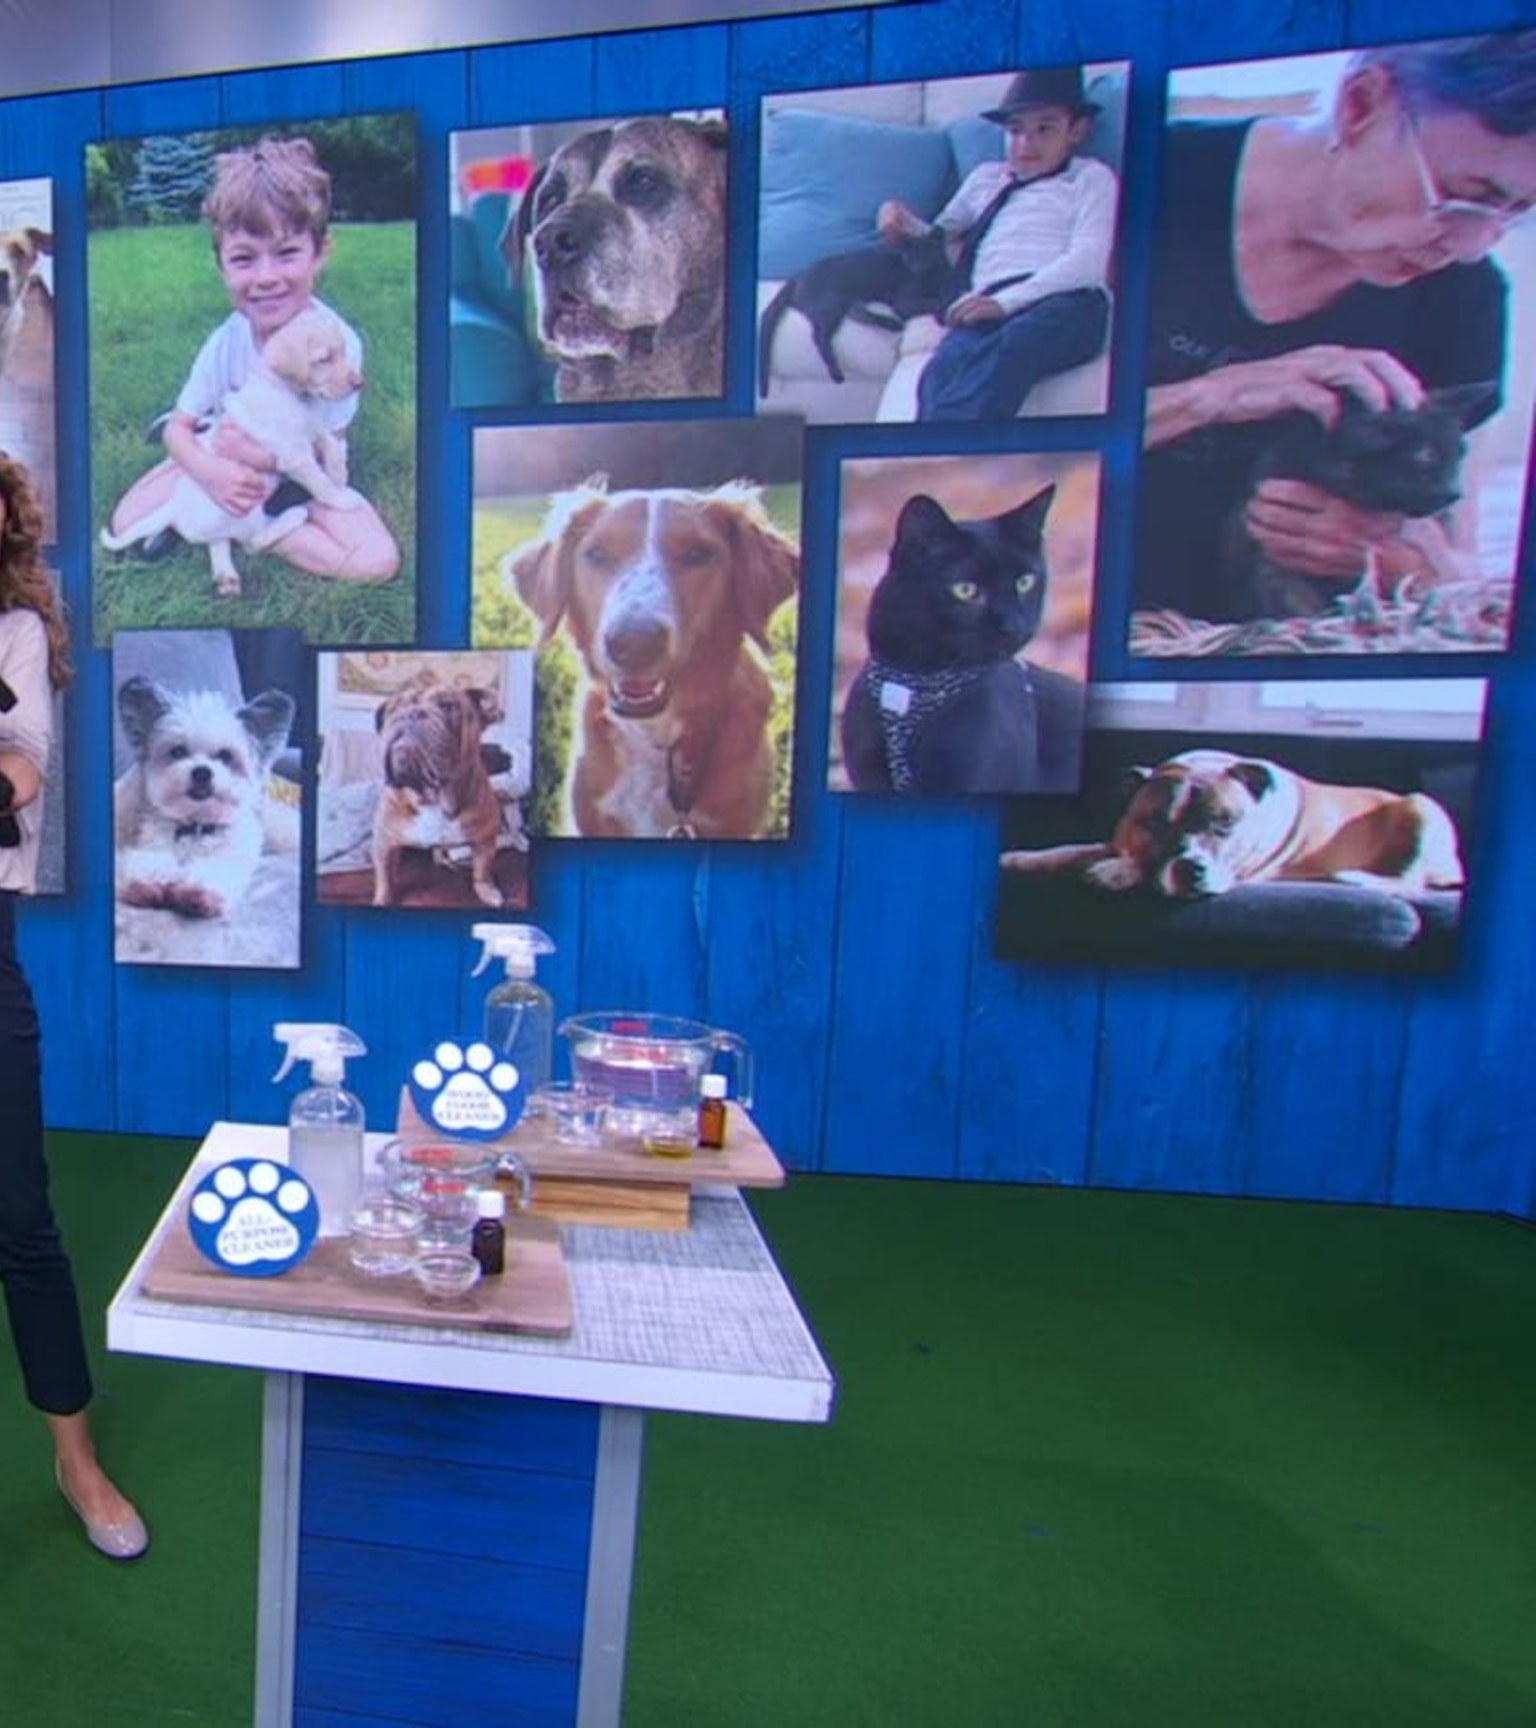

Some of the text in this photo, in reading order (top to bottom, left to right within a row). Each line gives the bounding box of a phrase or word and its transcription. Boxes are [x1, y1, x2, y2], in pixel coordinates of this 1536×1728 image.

[437, 1111, 501, 1121] CLEANER
[222, 1225, 288, 1242] PURPOSE
[222, 1236, 295, 1253] CLEANER
